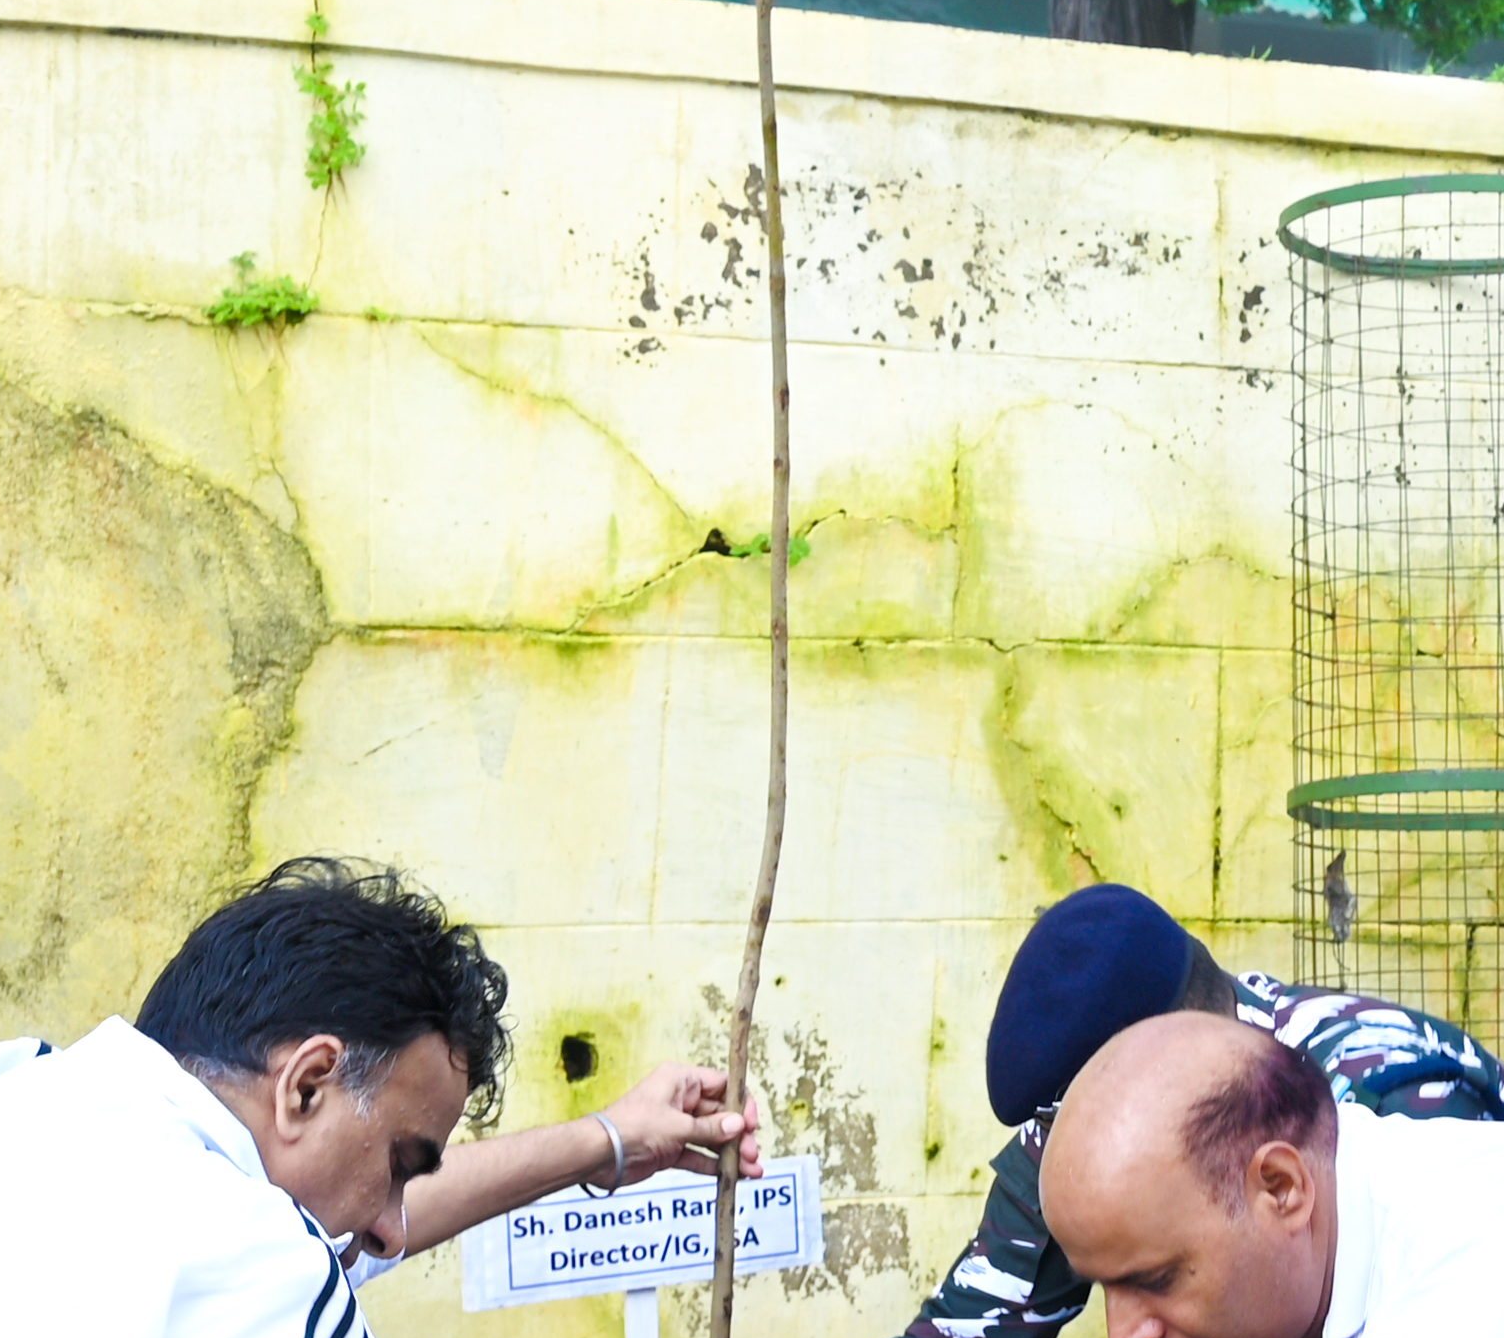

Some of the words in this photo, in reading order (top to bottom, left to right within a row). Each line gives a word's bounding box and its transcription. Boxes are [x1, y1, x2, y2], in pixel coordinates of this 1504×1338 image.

[513, 1215, 554, 1239] Sh.
[564, 1201, 662, 1232] Danesh
[672, 1197, 745, 1220] Ran,
[754, 1185, 792, 1210] IPS
[550, 1233, 710, 1271] Director/IG,
[732, 1226, 760, 1249] SA
